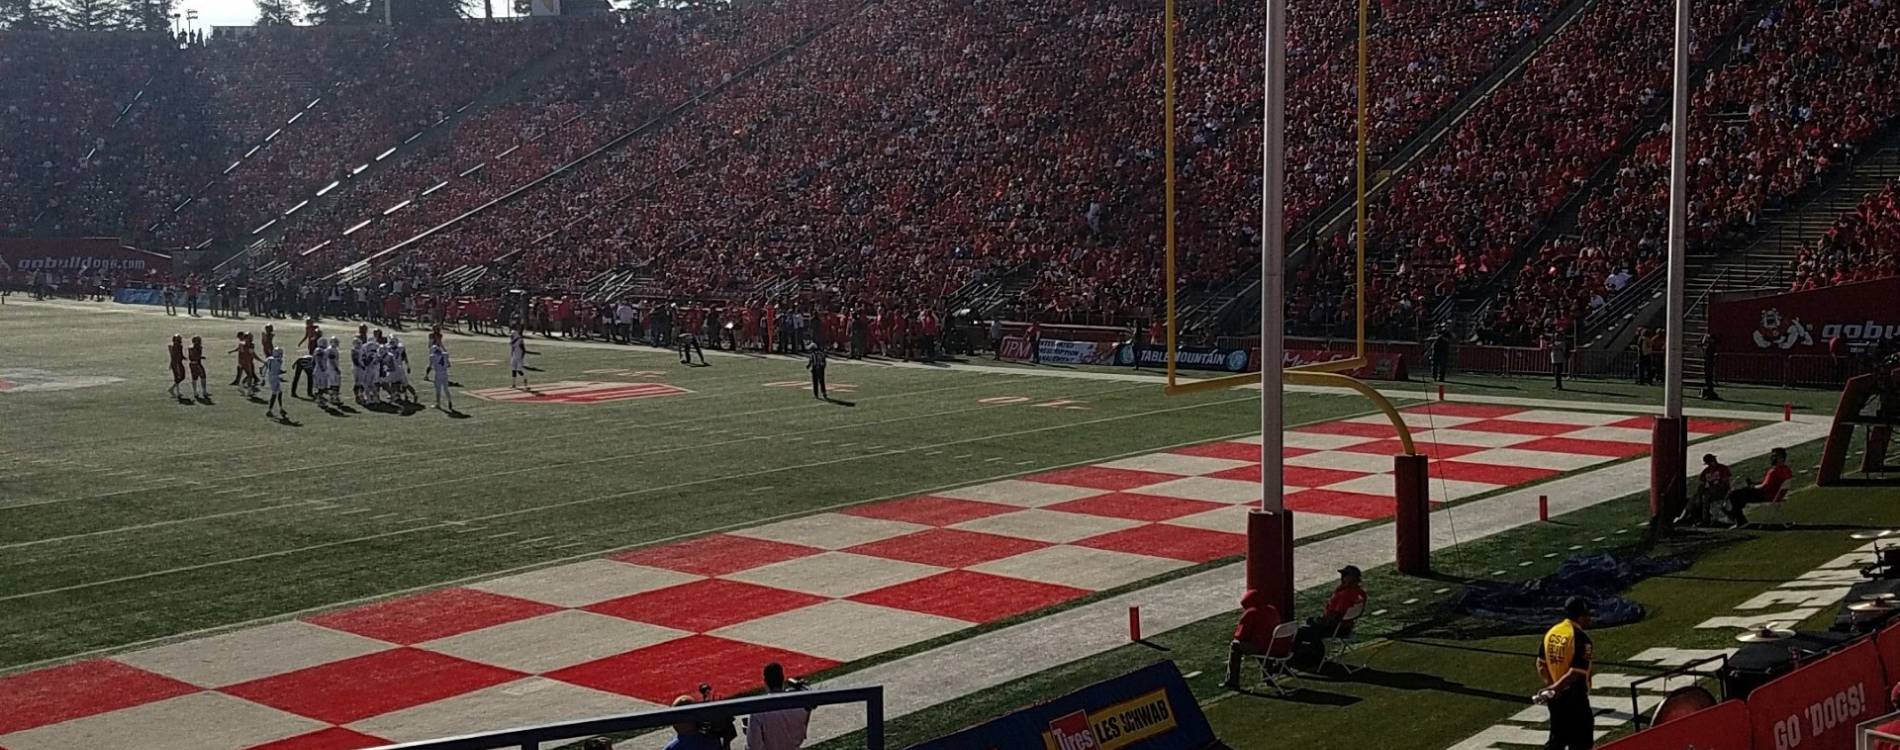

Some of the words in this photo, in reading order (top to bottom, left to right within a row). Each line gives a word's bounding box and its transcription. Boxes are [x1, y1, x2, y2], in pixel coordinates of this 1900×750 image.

[1053, 727, 1094, 750] Tires
[1094, 716, 1121, 744] LES
[1119, 699, 1169, 734] SCHWAB
[1773, 714, 1801, 750] GO
